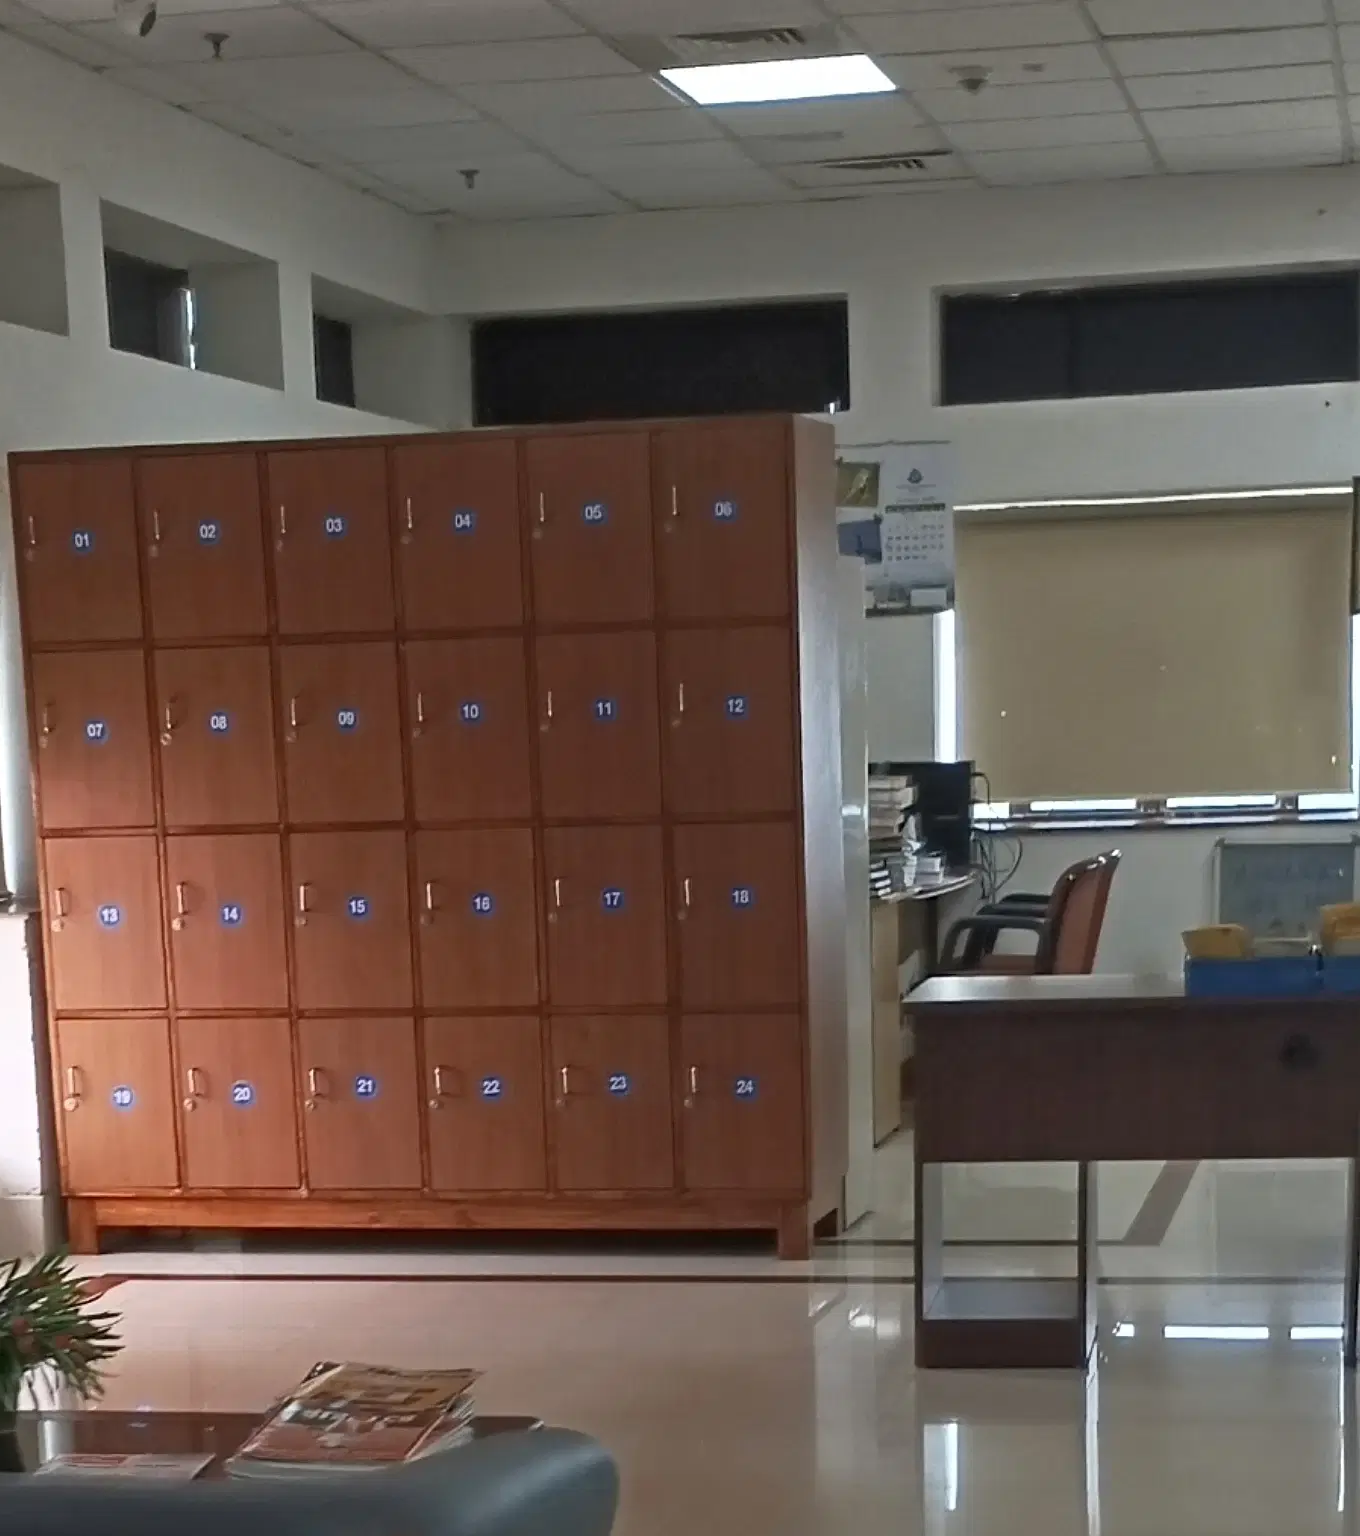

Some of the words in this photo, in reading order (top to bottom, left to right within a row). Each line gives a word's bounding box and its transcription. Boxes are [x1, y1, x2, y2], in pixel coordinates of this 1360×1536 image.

[585, 505, 602, 519] 05
[716, 503, 732, 516] 06
[326, 518, 342, 533] 03
[455, 514, 470, 528] 04
[199, 524, 216, 538] 02
[74, 533, 89, 548] 01
[463, 704, 479, 718] 10
[598, 702, 611, 715] 11
[728, 699, 743, 712] 12
[210, 715, 228, 730] 08
[338, 711, 355, 725] 09
[86, 723, 104, 737] 07
[474, 896, 490, 910] 16
[605, 891, 621, 905] 17
[733, 890, 749, 903] 18
[223, 906, 239, 921] 14
[350, 899, 366, 914] 15
[101, 907, 118, 922] 13
[357, 1079, 373, 1093] 21
[482, 1079, 500, 1095] 22
[609, 1076, 627, 1090] 23
[737, 1080, 754, 1093] 24
[114, 1090, 131, 1105] 19
[233, 1086, 250, 1101] 20
